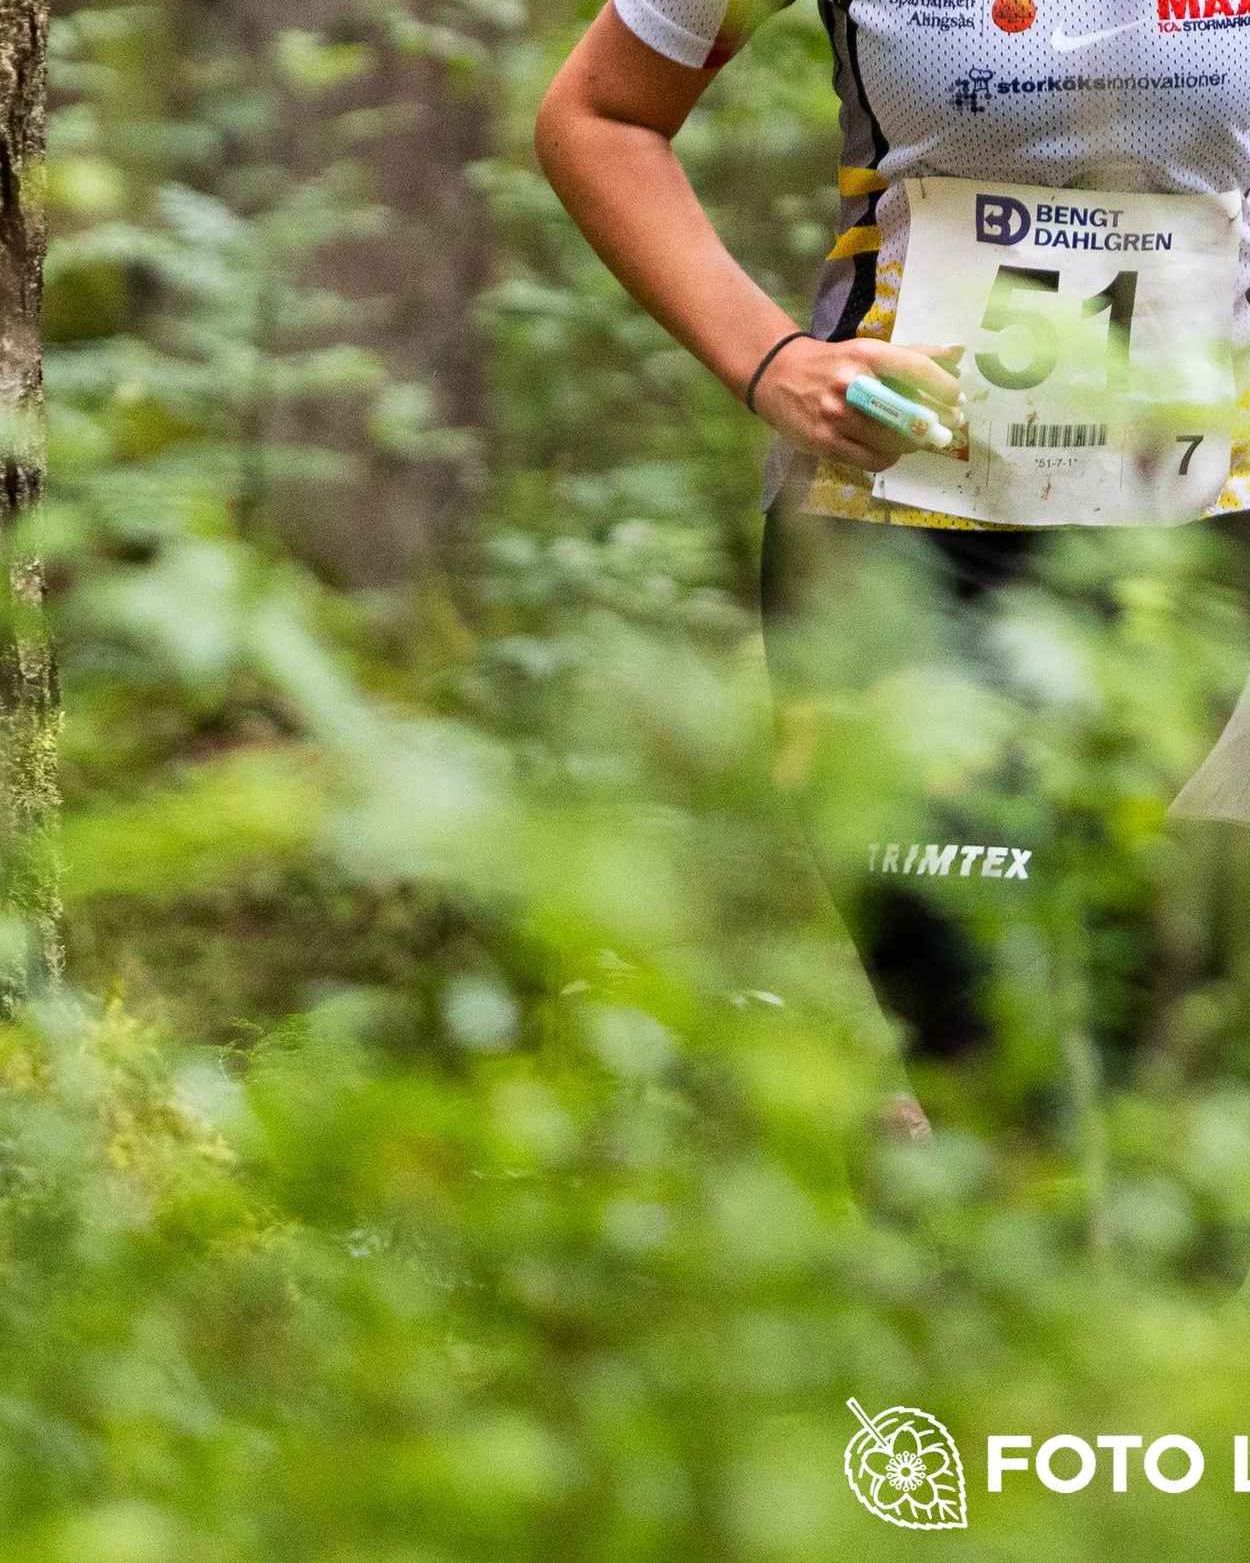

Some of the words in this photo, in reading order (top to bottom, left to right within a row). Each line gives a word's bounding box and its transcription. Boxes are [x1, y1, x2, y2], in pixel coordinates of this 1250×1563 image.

[997, 71, 1229, 94] storköksinnovationer
[1036, 204, 1124, 227] BENGT
[1034, 227, 1172, 251] DAHLGREN
[974, 265, 1138, 390] 51
[1176, 435, 1204, 475] 7
[868, 844, 1033, 880] TRIMTEX
